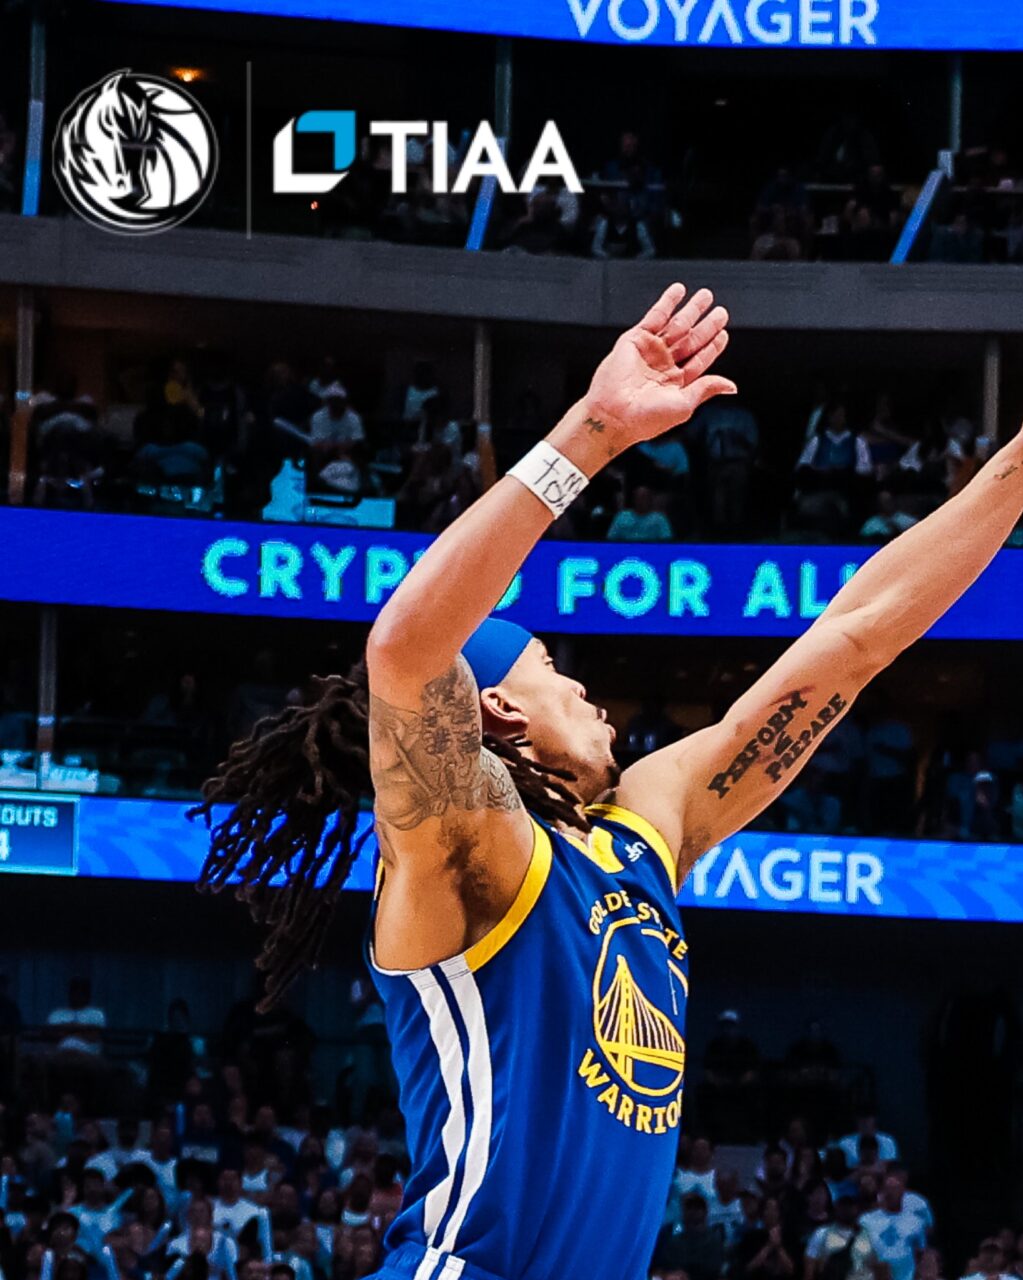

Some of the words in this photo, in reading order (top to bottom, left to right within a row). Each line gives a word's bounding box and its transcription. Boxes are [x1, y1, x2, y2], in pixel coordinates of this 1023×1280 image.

[567, 0, 879, 45] VOYAGER
[202, 537, 522, 611] CRYP
[557, 556, 711, 618] FOR
[707, 691, 808, 799] PERFORM
[765, 692, 848, 784] PREPARE
[691, 845, 884, 905] YAGER
[637, 902, 689, 960] STTE
